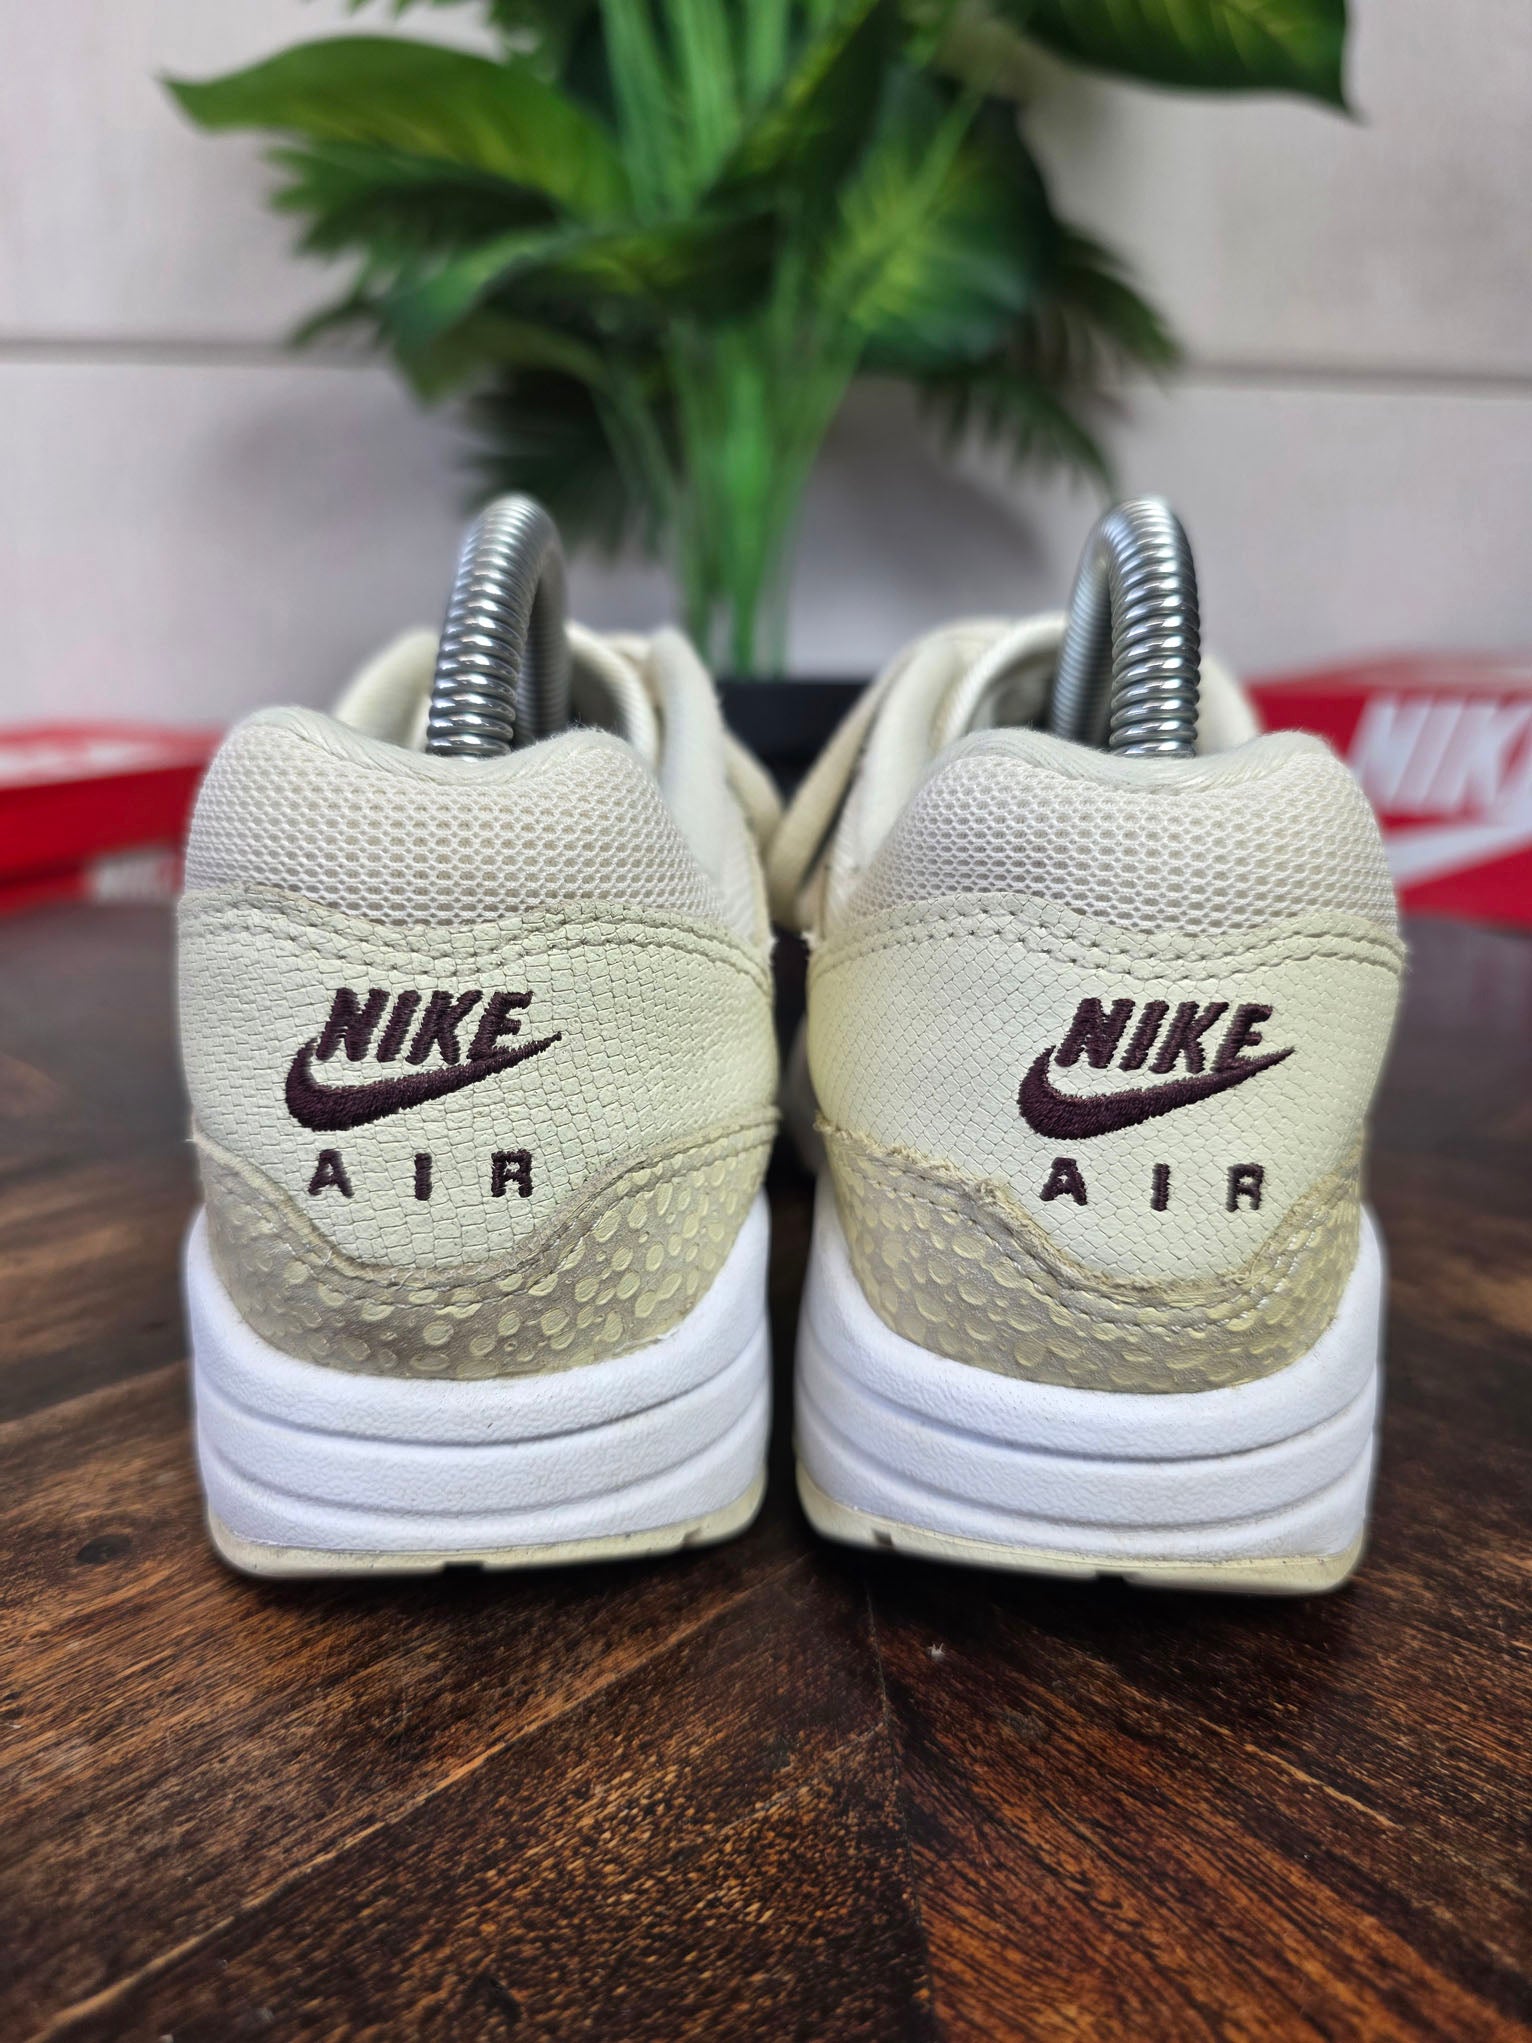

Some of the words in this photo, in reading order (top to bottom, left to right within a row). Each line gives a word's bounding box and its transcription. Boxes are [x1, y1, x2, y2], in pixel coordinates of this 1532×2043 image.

[1350, 692, 1532, 806] NIK
[315, 987, 534, 1065] NIKE
[1053, 997, 1273, 1075] NIKE
[307, 1148, 535, 1201] AIR
[1039, 1156, 1265, 1213] AIR
